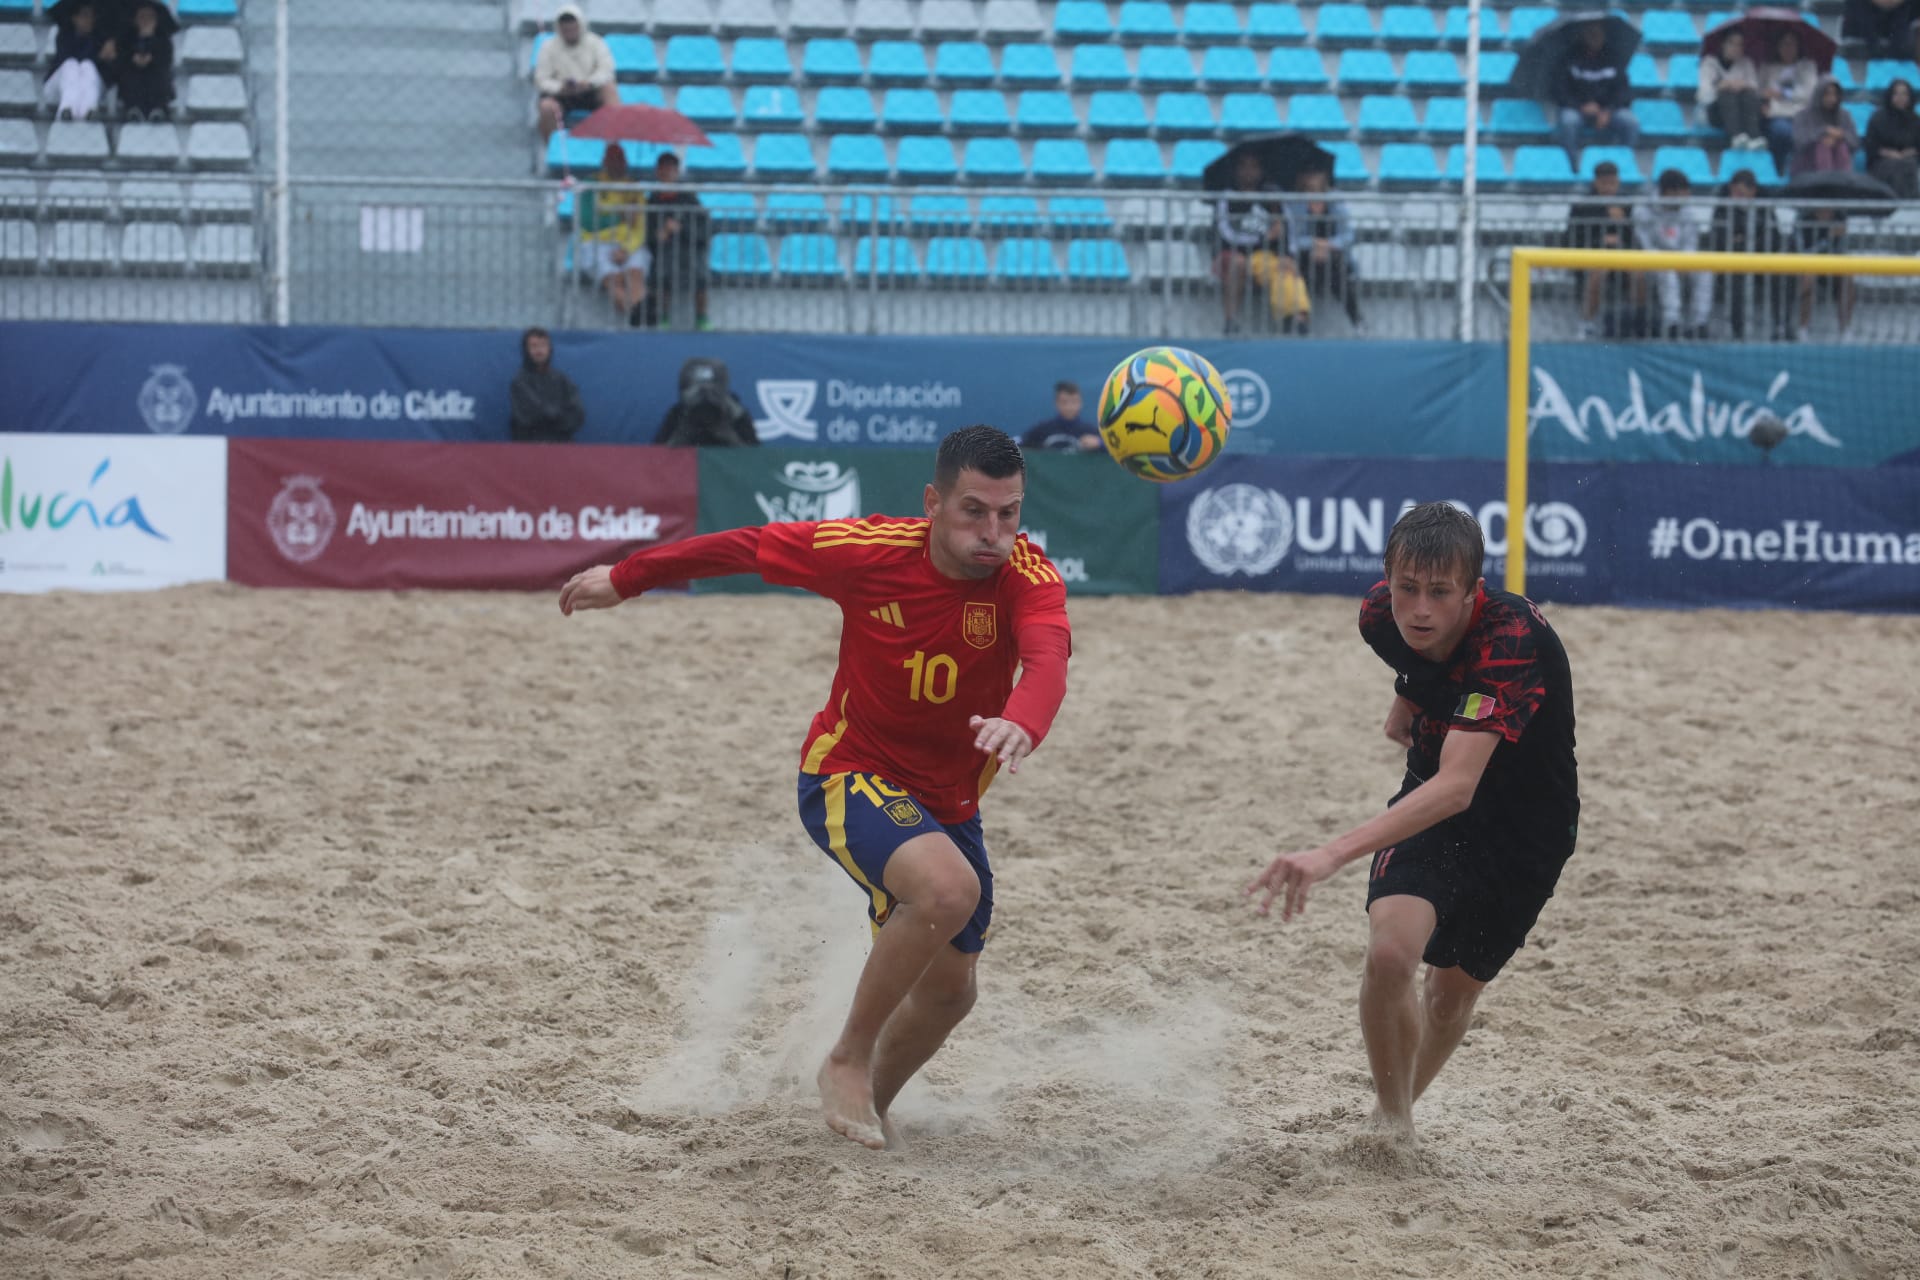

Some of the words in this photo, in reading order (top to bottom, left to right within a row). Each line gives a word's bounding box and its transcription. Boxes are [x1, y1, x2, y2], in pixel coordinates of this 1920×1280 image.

[206, 388, 367, 423] Ayuntamiento
[370, 390, 401, 420] de
[404, 390, 475, 420] Cádiz
[826, 379, 962, 410] Diputación
[826, 416, 860, 443] de
[867, 414, 937, 443] Cádiz
[347, 503, 534, 545] Ayuntamiento
[537, 507, 574, 541] de
[578, 506, 661, 541] Cádiz
[904, 651, 958, 704] 10
